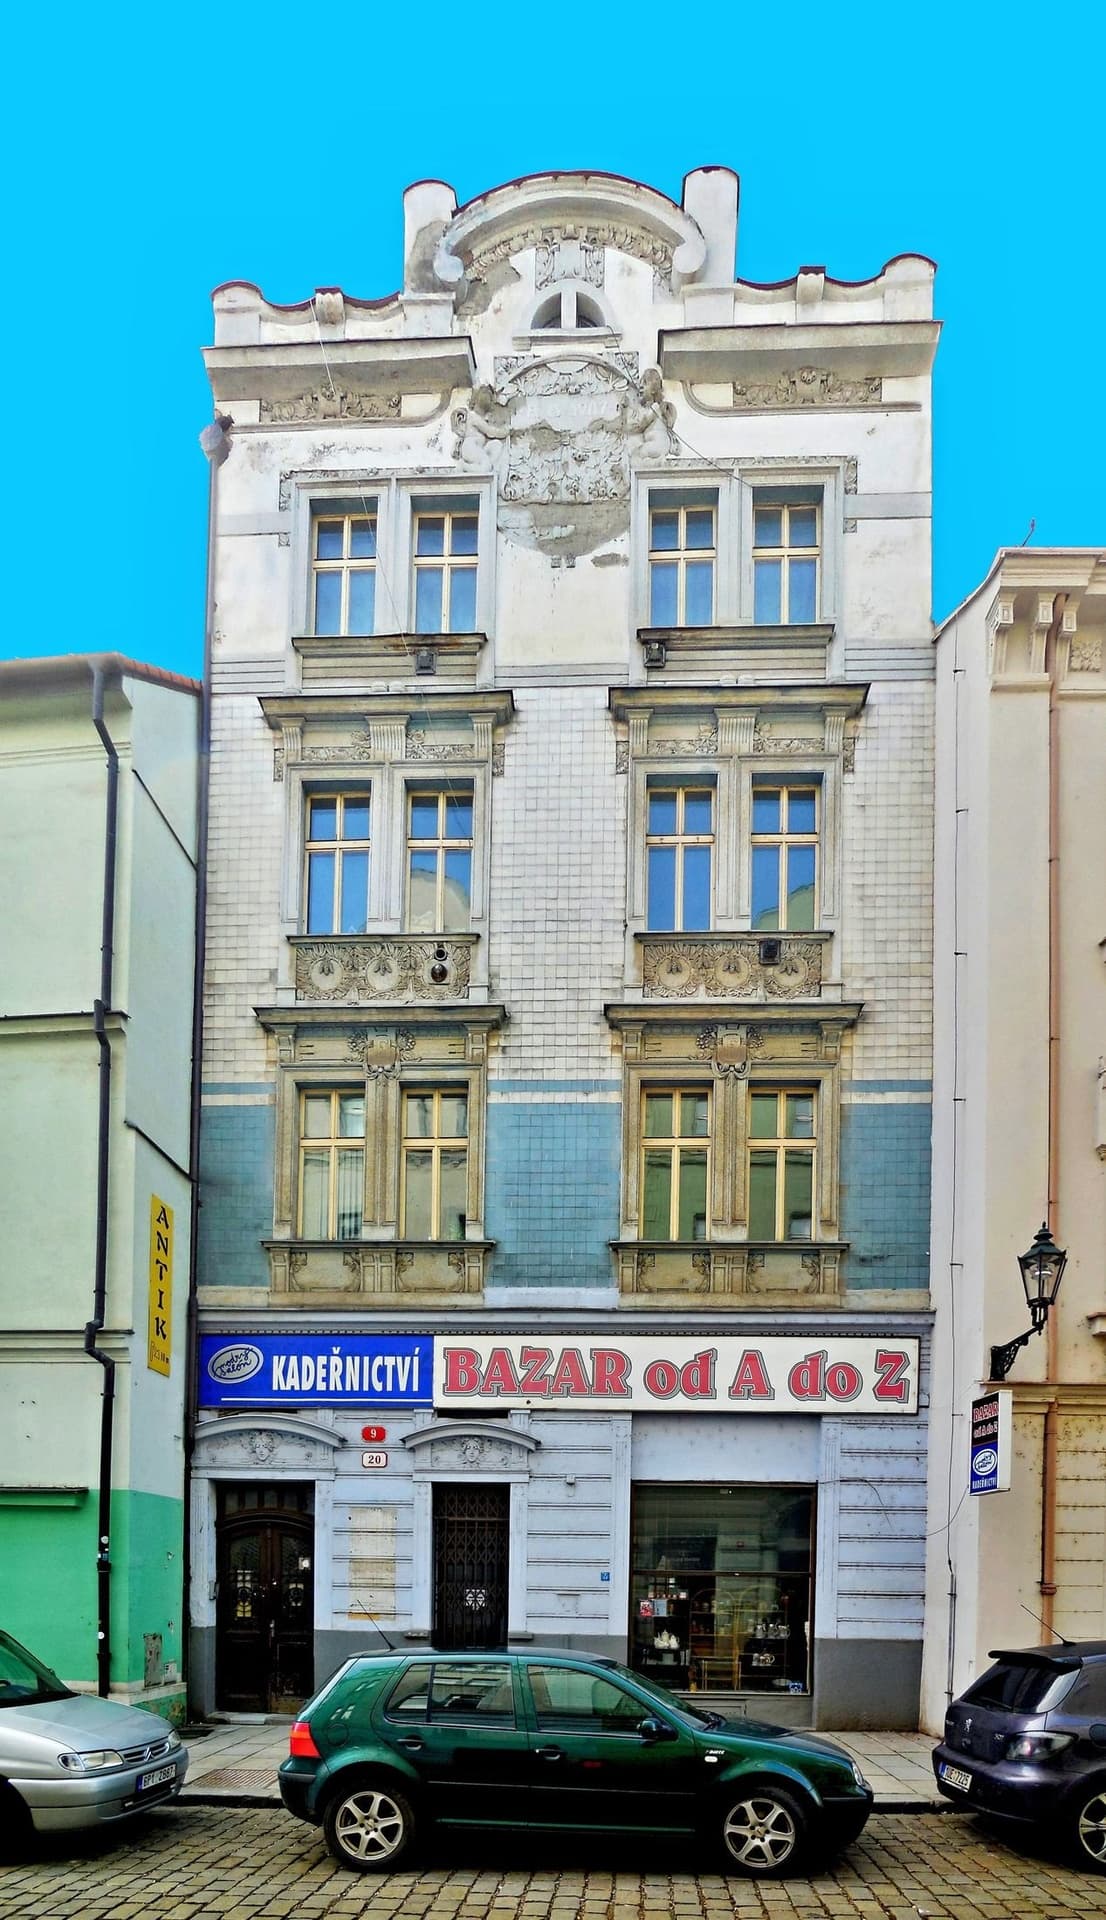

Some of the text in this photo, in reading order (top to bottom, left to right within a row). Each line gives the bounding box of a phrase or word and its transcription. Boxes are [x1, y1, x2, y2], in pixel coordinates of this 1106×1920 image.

[155, 1206, 170, 1340] ANTIK
[272, 1347, 420, 1392] KADEŘNICTVÍ
[443, 1346, 909, 1404] BAZAR od A do Z
[370, 1428, 377, 1439] 9
[368, 1455, 381, 1465] 20
